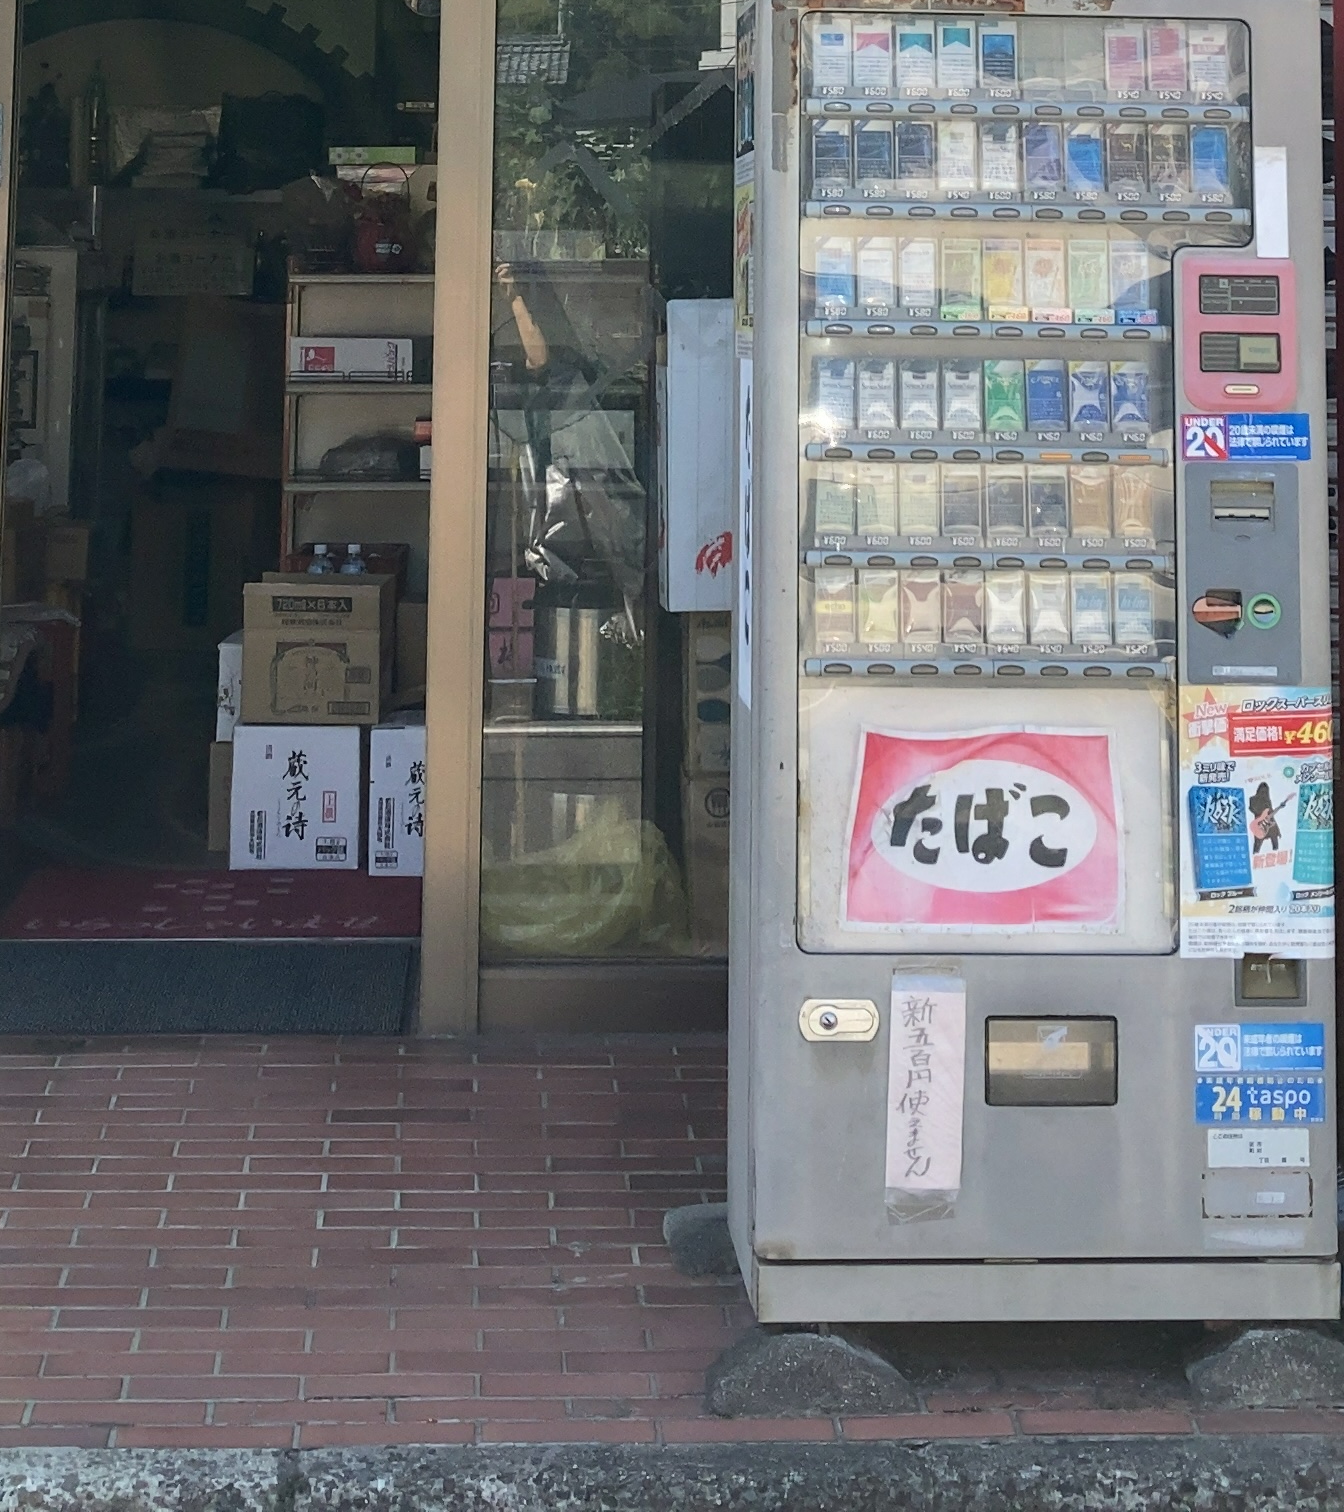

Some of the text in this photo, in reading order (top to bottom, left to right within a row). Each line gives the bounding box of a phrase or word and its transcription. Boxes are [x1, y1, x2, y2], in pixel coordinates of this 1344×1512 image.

[1184, 417, 1224, 427] UNDER
[1186, 428, 1226, 458] 20
[1229, 437, 1309, 447] 法律で禁じられています
[1193, 702, 1228, 719] New
[1233, 726, 1283, 744] 満足価格!
[282, 750, 309, 840] 蔵元の詩
[889, 781, 1072, 868] たばこ
[896, 995, 938, 1178] 新五百円使えません
[1247, 1086, 1311, 1109] taspo
[1212, 1086, 1243, 1112] 24
